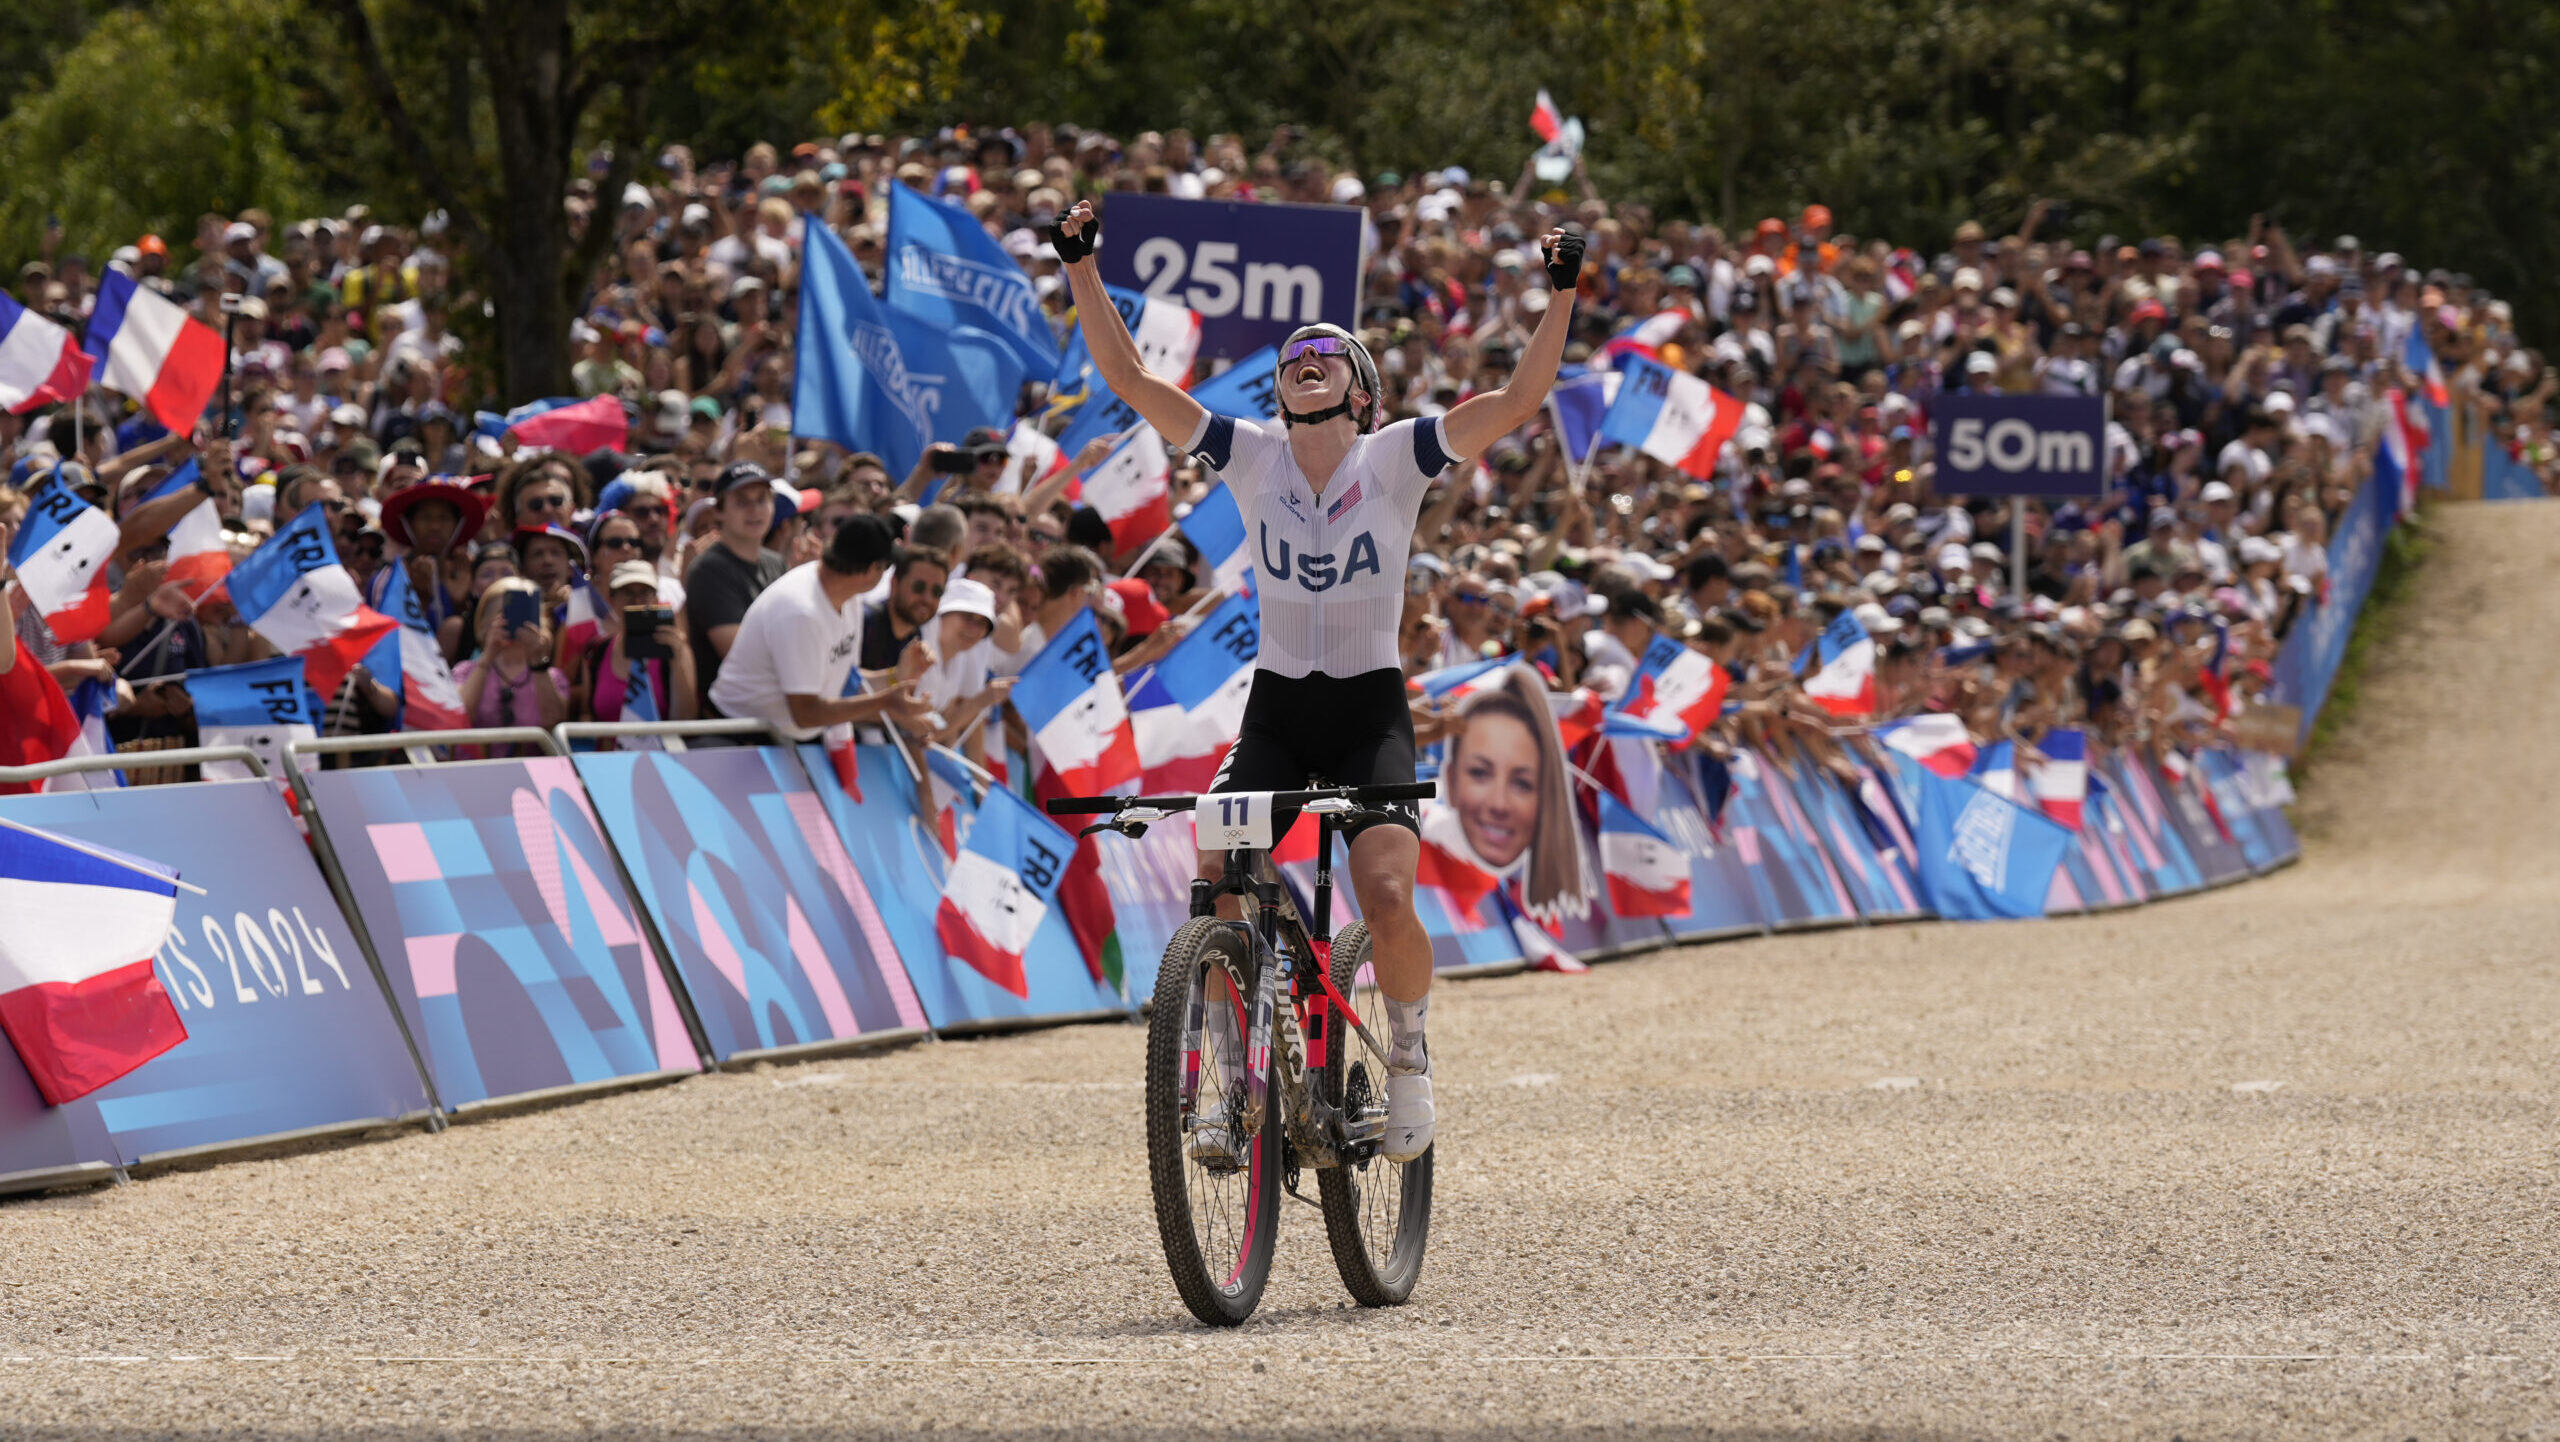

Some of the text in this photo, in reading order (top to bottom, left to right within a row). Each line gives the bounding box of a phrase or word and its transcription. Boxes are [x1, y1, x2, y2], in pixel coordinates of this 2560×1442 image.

[1133, 236, 1323, 323] 25m
[1948, 417, 2093, 473] 50m
[1279, 495, 1307, 524] CUORE
[279, 526, 332, 573] FR
[1260, 519, 1380, 593] USA
[1217, 796, 1249, 827] 11
[202, 906, 351, 1003] 2024
